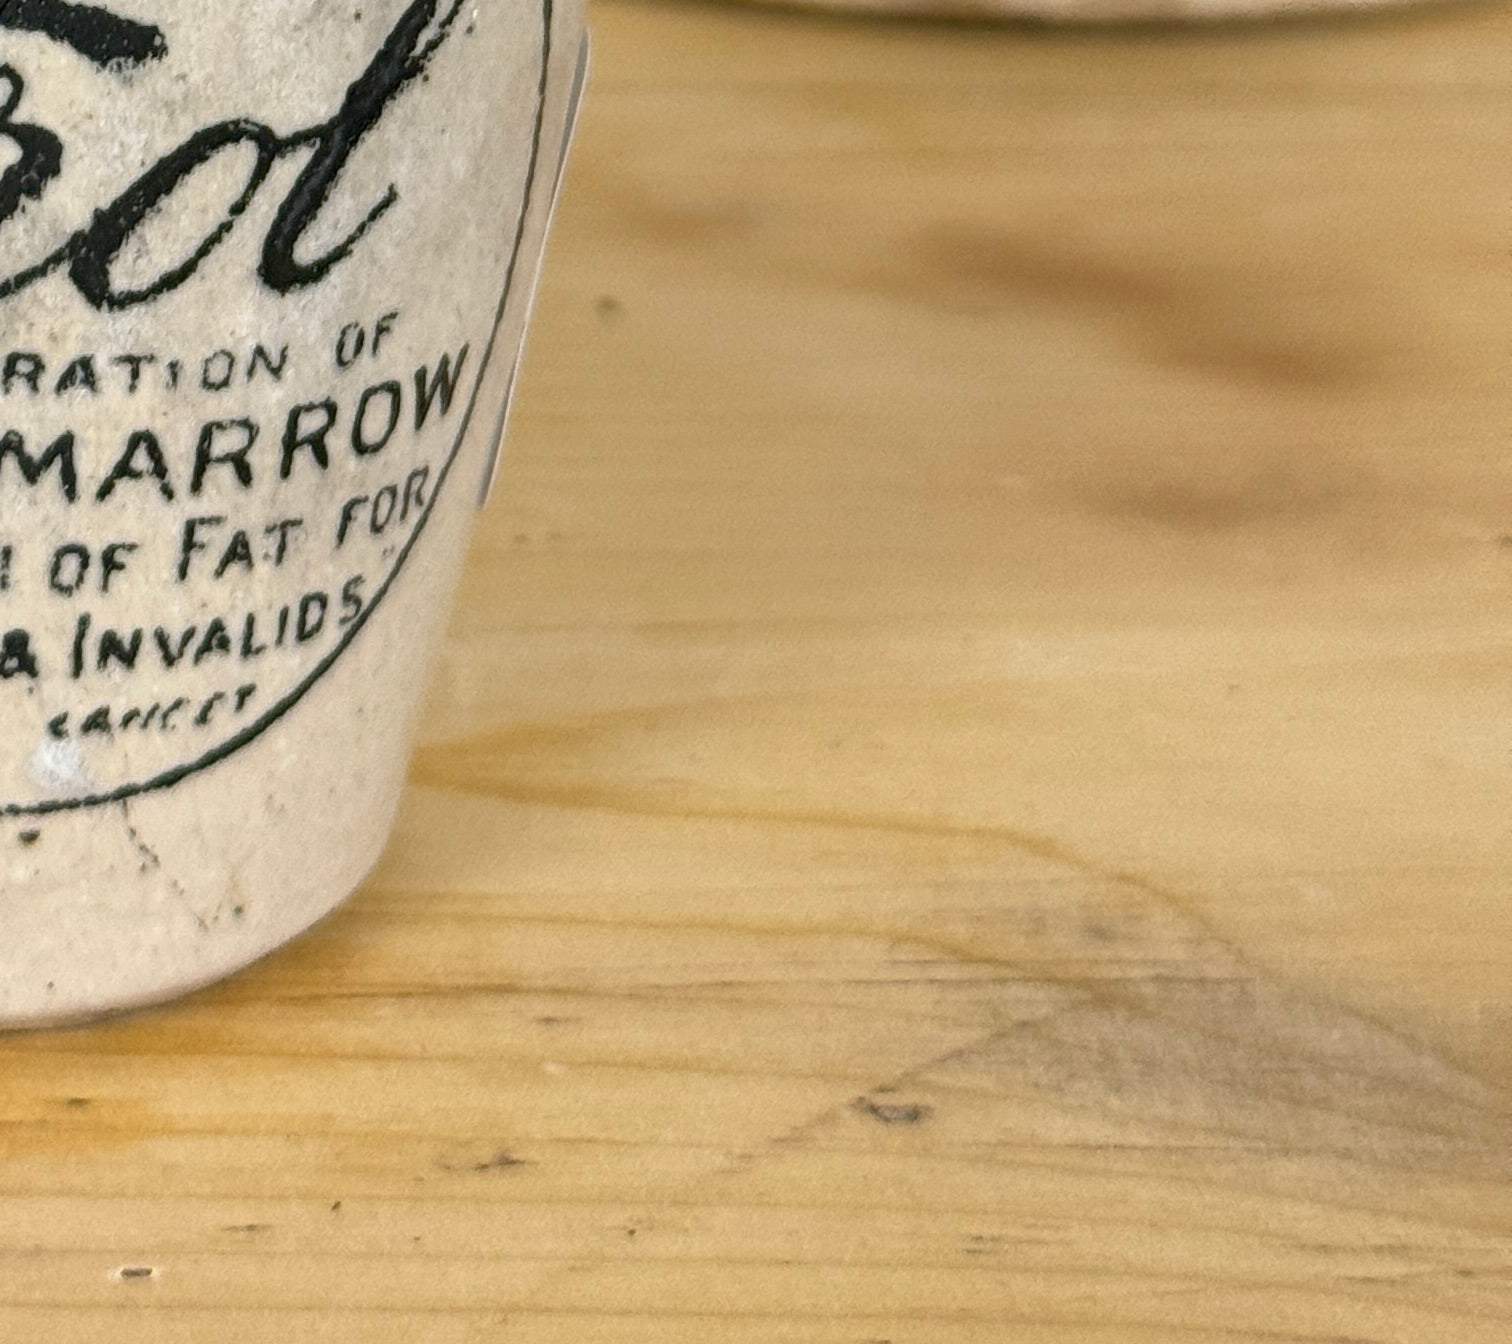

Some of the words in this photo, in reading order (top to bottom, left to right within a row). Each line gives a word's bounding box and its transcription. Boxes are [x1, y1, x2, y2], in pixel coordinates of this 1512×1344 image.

[335, 311, 400, 373] OF
[48, 541, 140, 599] OF
[176, 515, 304, 583] FAT
[335, 465, 430, 550] FOR
